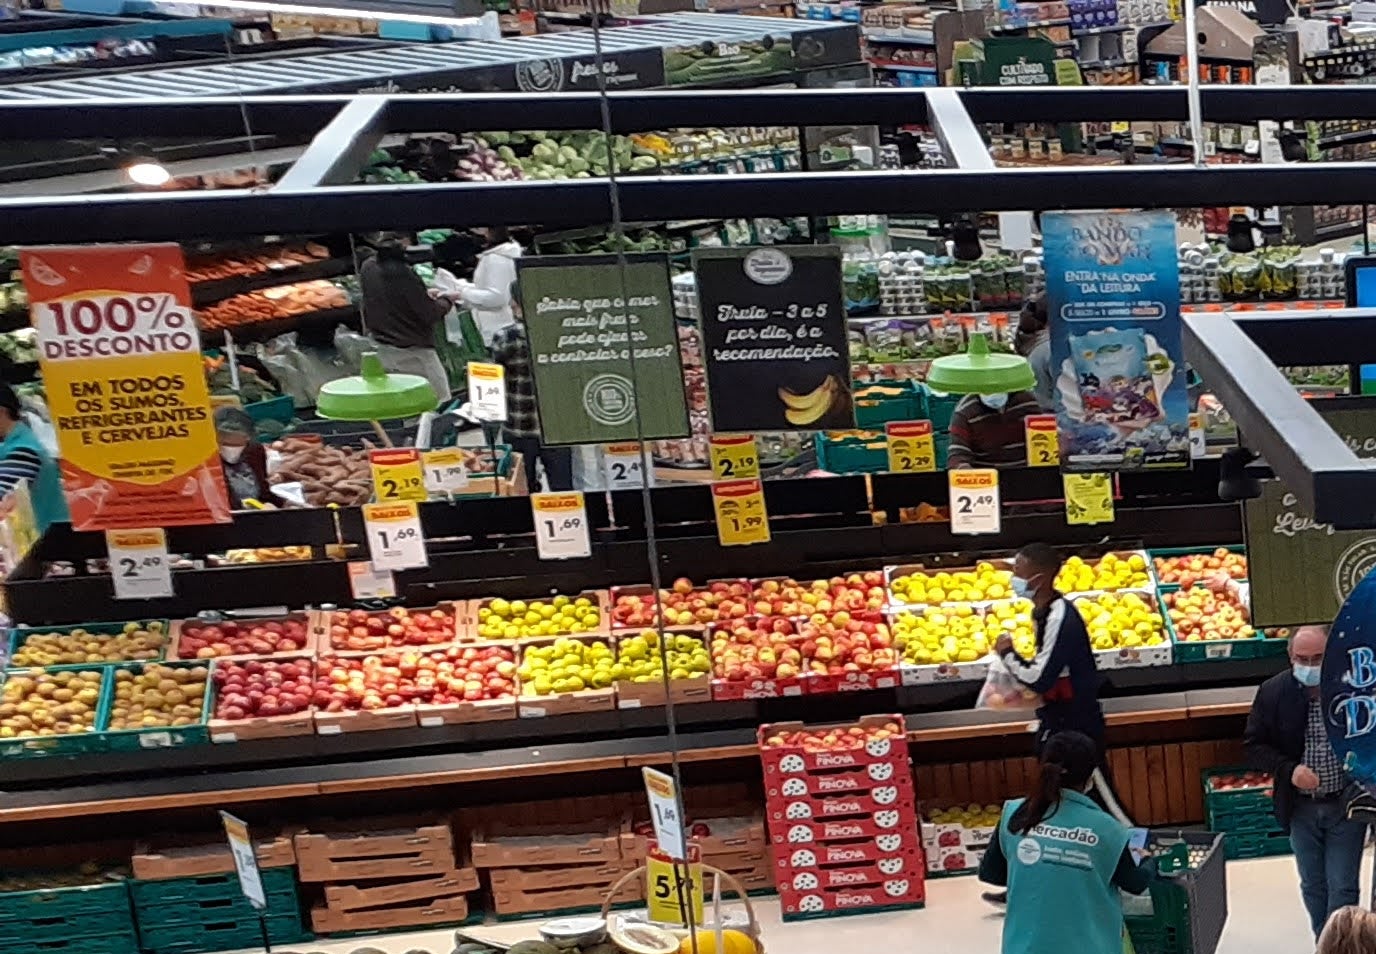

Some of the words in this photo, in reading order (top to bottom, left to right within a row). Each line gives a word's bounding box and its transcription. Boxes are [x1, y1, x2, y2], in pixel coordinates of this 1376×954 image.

[48, 296, 186, 337] 100%
[45, 331, 193, 359] DESCONTO
[70, 381, 103, 398] EM
[109, 375, 185, 394] TODOS
[76, 399, 104, 413] OS
[58, 407, 207, 431] REFRIGERANTES
[82, 431, 93, 445] E
[99, 424, 190, 445] CERVEJAS
[612, 462, 643, 481] 2,4
[382, 477, 420, 498] 2,19
[958, 495, 993, 514] 2,49
[378, 528, 418, 549] 1,69
[544, 518, 581, 538] 1,69
[120, 556, 162, 577] 2,49
